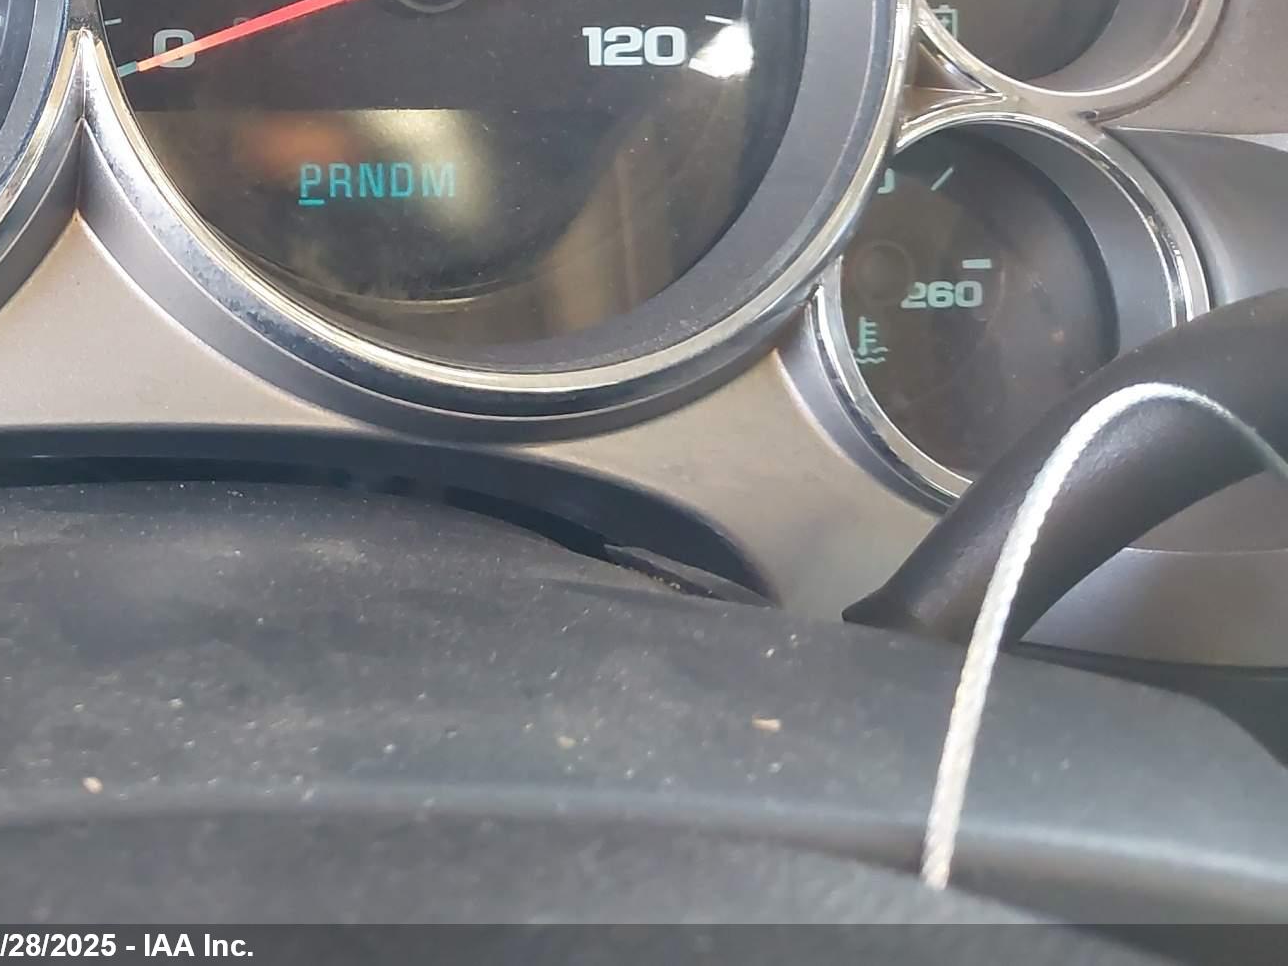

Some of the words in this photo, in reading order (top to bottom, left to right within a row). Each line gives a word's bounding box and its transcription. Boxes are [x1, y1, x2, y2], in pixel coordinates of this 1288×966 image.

[153, 28, 196, 68] 0
[582, 26, 686, 68] 120
[900, 280, 984, 310] 260
